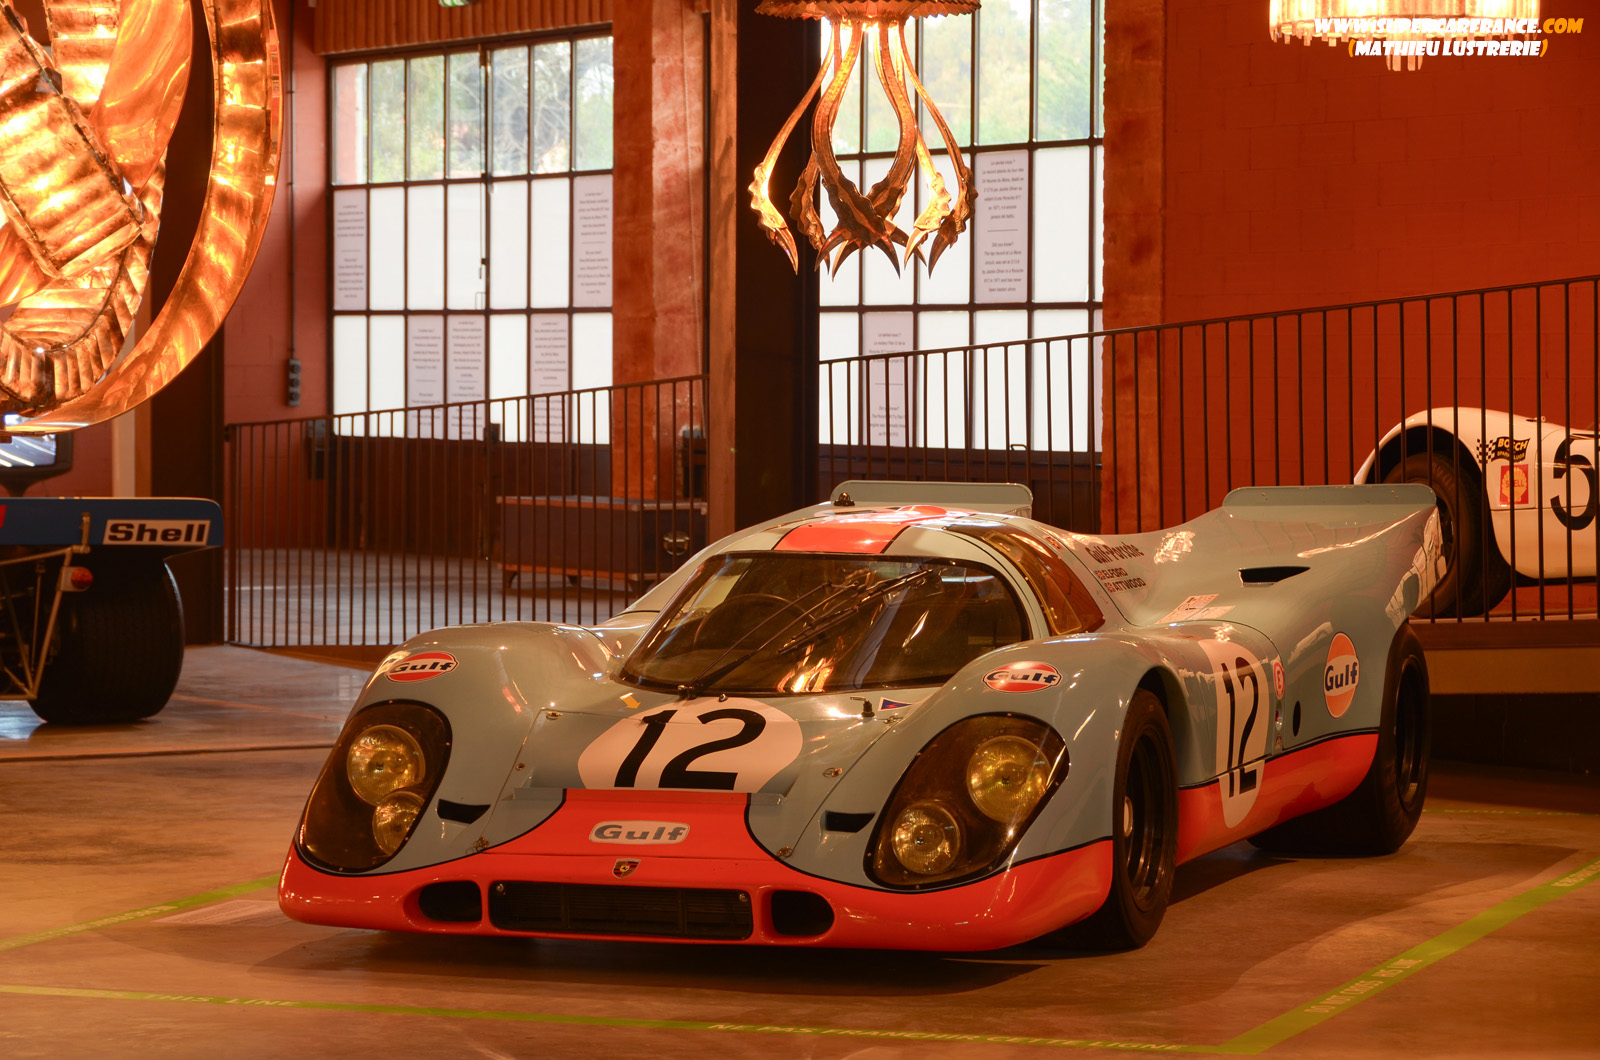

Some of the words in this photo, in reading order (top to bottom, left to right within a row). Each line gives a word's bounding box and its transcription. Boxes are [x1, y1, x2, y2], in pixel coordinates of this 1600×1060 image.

[1497, 437, 1529, 451] BOCH
[1505, 478, 1525, 488] SELL
[108, 522, 207, 543] Shell
[1084, 541, 1145, 564] Gulf-Porsche
[1111, 577, 1147, 591] ATTWOOD
[390, 661, 455, 674] Gulf
[986, 670, 1059, 684] Gulf
[1324, 661, 1359, 692] Gulf
[1220, 656, 1258, 799] 12
[613, 708, 767, 791] 12
[593, 824, 689, 841] Gulf
[143, 994, 215, 1003] THIS
[225, 998, 300, 1007] LINE
[707, 1023, 754, 1031] NE
[756, 1026, 818, 1034] PAS
[820, 1028, 981, 1041] FRANCHIR
[986, 1036, 1086, 1047] CETTE
[1087, 1041, 1189, 1051] LIGNE
